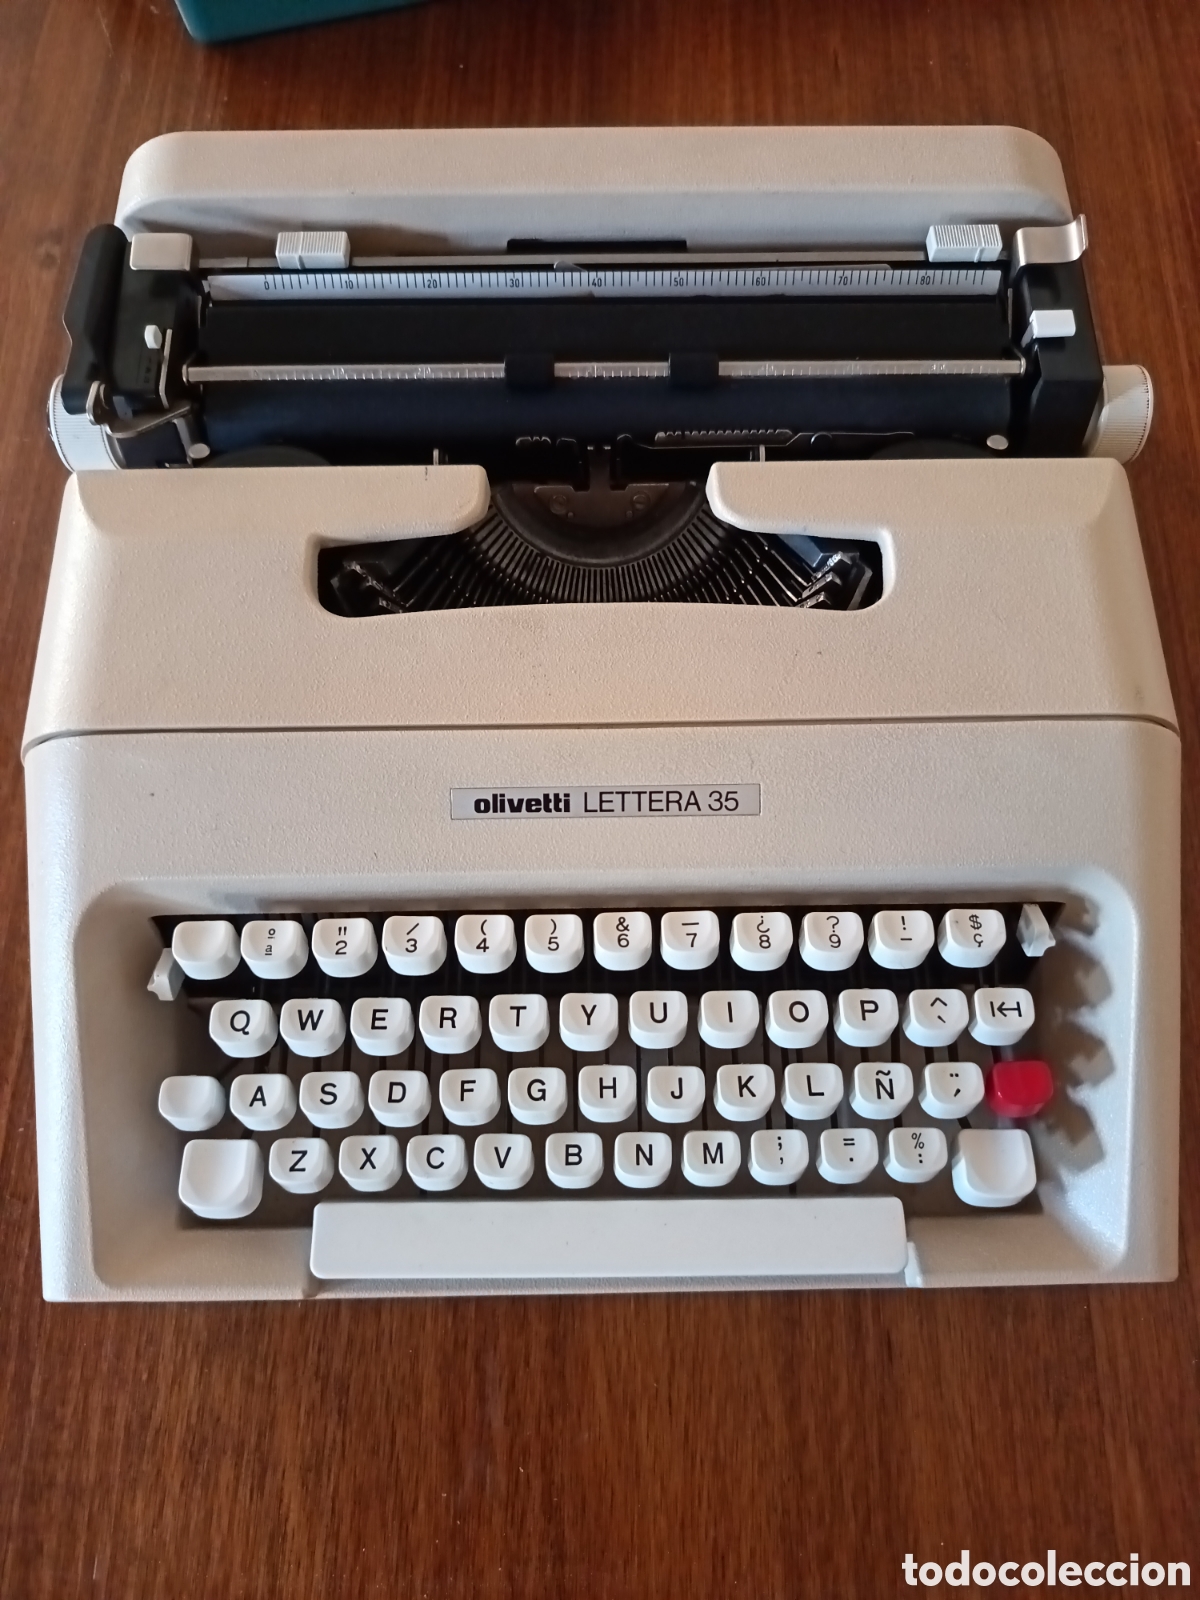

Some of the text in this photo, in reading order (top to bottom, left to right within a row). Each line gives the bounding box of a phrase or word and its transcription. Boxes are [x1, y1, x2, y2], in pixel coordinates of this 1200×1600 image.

[263, 275, 931, 291] 0 10 20 30 40 50 60 70 80
[474, 791, 739, 813] olivetti LETTERA 35
[481, 920, 487, 935] (
[551, 919, 556, 935] )
[616, 917, 629, 932] &
[827, 916, 839, 935] ?
[902, 916, 906, 930] !
[969, 915, 982, 929] $
[335, 940, 347, 955] 2
[406, 938, 417, 953] 3
[476, 938, 489, 952] 4
[548, 934, 559, 951] 5
[618, 934, 629, 947] 6
[686, 933, 697, 947] 7
[759, 932, 771, 949] 8
[829, 934, 841, 948] 9
[298, 1010, 323, 1030] W
[371, 1009, 388, 1030] E
[440, 1007, 457, 1028] R
[510, 1006, 526, 1027] T
[581, 1005, 596, 1025] Y
[650, 1002, 667, 1023] U
[728, 1002, 733, 1022] I
[789, 1001, 809, 1022] O
[860, 1000, 878, 1021] P
[230, 1010, 250, 1035] Q
[320, 1083, 337, 1105] S
[388, 1082, 406, 1103] D
[461, 1080, 476, 1101] F
[527, 1079, 546, 1101] G
[599, 1077, 616, 1098] H
[671, 1078, 683, 1099] J
[738, 1076, 756, 1097] K
[807, 1075, 824, 1096] L
[876, 1070, 894, 1099] Ñ
[249, 1086, 266, 1107] A
[843, 1138, 855, 1146] =
[911, 1133, 924, 1149] %
[289, 1150, 307, 1172] Z
[360, 1148, 376, 1170] X
[426, 1147, 444, 1169] C
[494, 1147, 511, 1168] V
[565, 1144, 582, 1166] B
[636, 1144, 652, 1166] N
[703, 1143, 723, 1164] M
